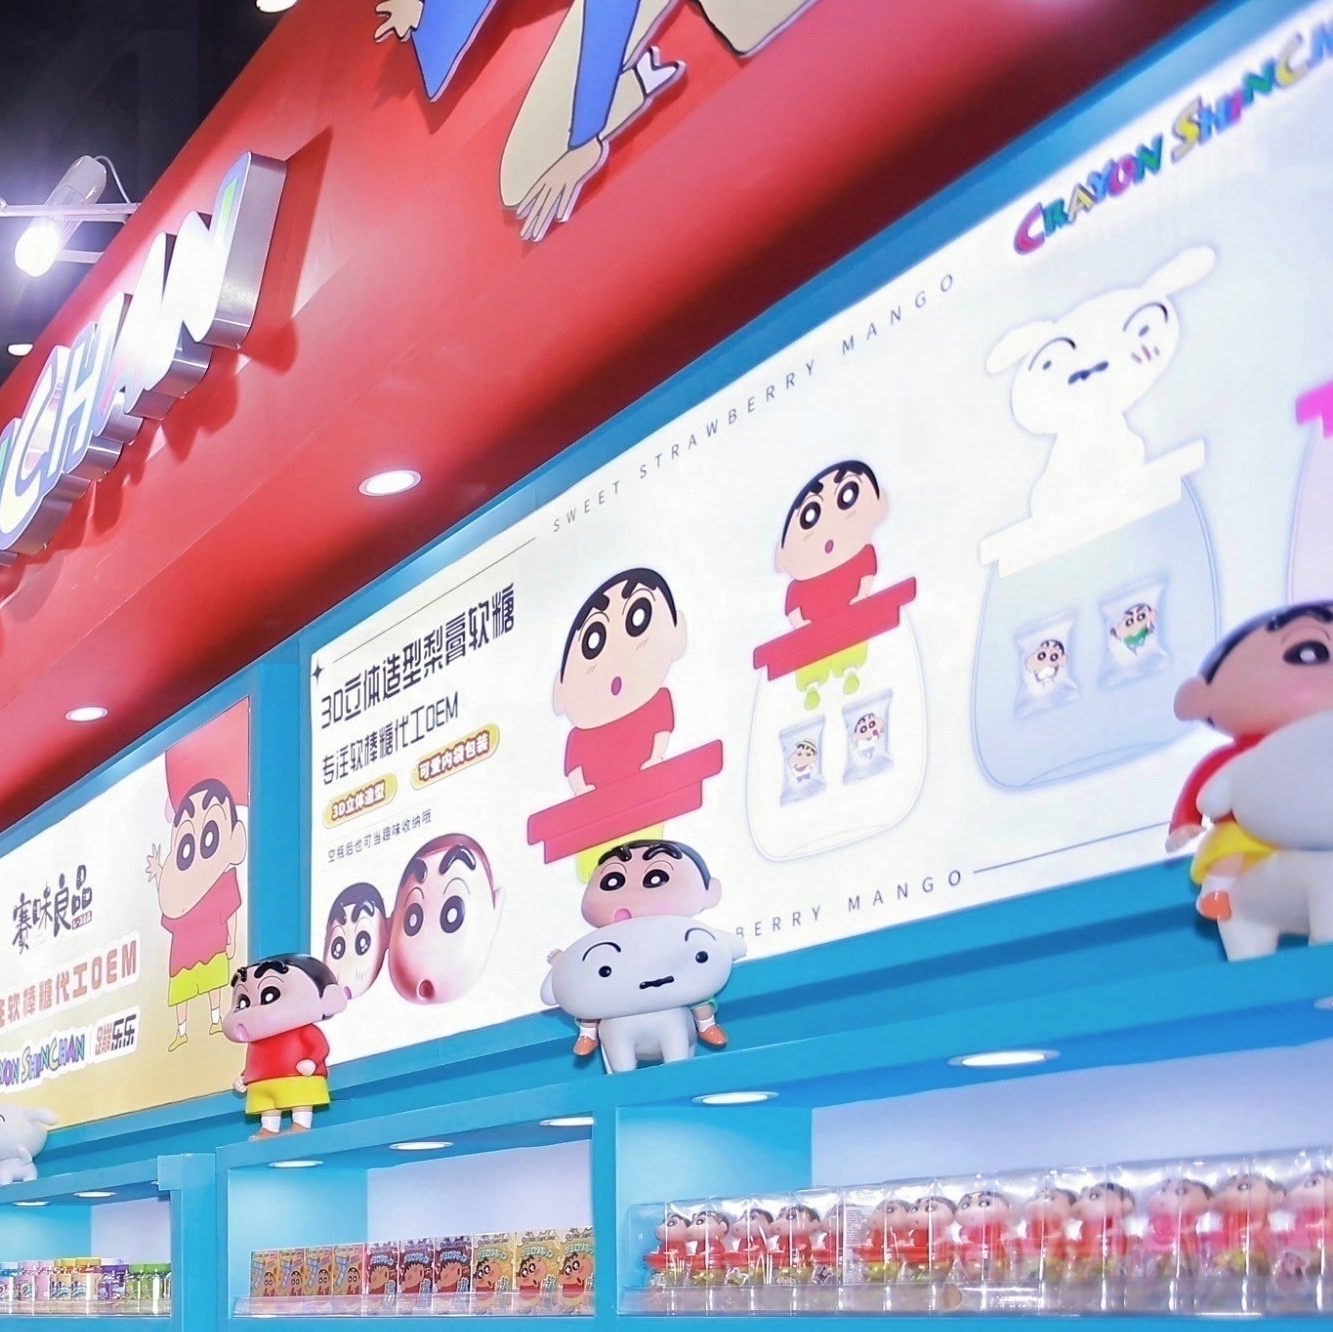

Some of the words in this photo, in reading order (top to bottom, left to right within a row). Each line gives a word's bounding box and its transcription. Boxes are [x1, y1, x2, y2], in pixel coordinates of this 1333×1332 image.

[1013, 133, 1164, 256] CRAYON
[553, 481, 621, 533] SWEET
[639, 358, 816, 480] STRAWBERRY
[841, 274, 954, 356] MANGO
[321, 583, 515, 730] 3D立体造型梨膏软糖
[322, 691, 459, 785] 专注软棒糖代工OEM
[331, 782, 386, 821] 3D立体造型
[12, 864, 93, 955] 赛味良品
[846, 869, 963, 914] MANGO
[21, 1033, 85, 1084] SHINCHAN
[95, 1013, 137, 1056] 蹦乐乐
